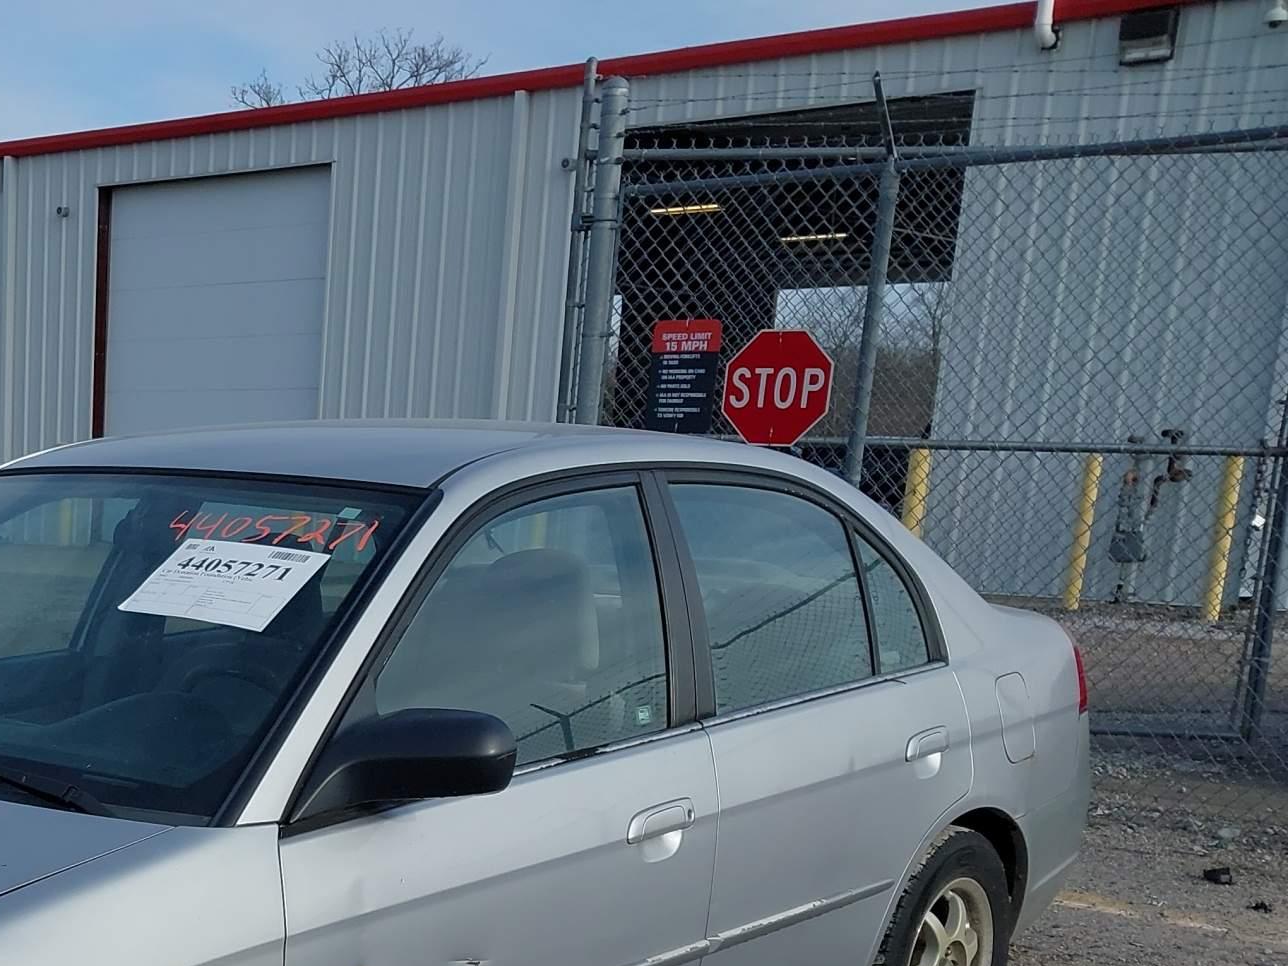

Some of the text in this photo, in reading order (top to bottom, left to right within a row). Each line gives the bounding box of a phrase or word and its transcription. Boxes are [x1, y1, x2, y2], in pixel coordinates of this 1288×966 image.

[662, 332, 712, 341] SPEED LIMIT
[665, 340, 708, 351] 15 MPH
[729, 366, 825, 409] STOP
[169, 510, 379, 551] 44057271
[176, 556, 293, 582] 44057271
